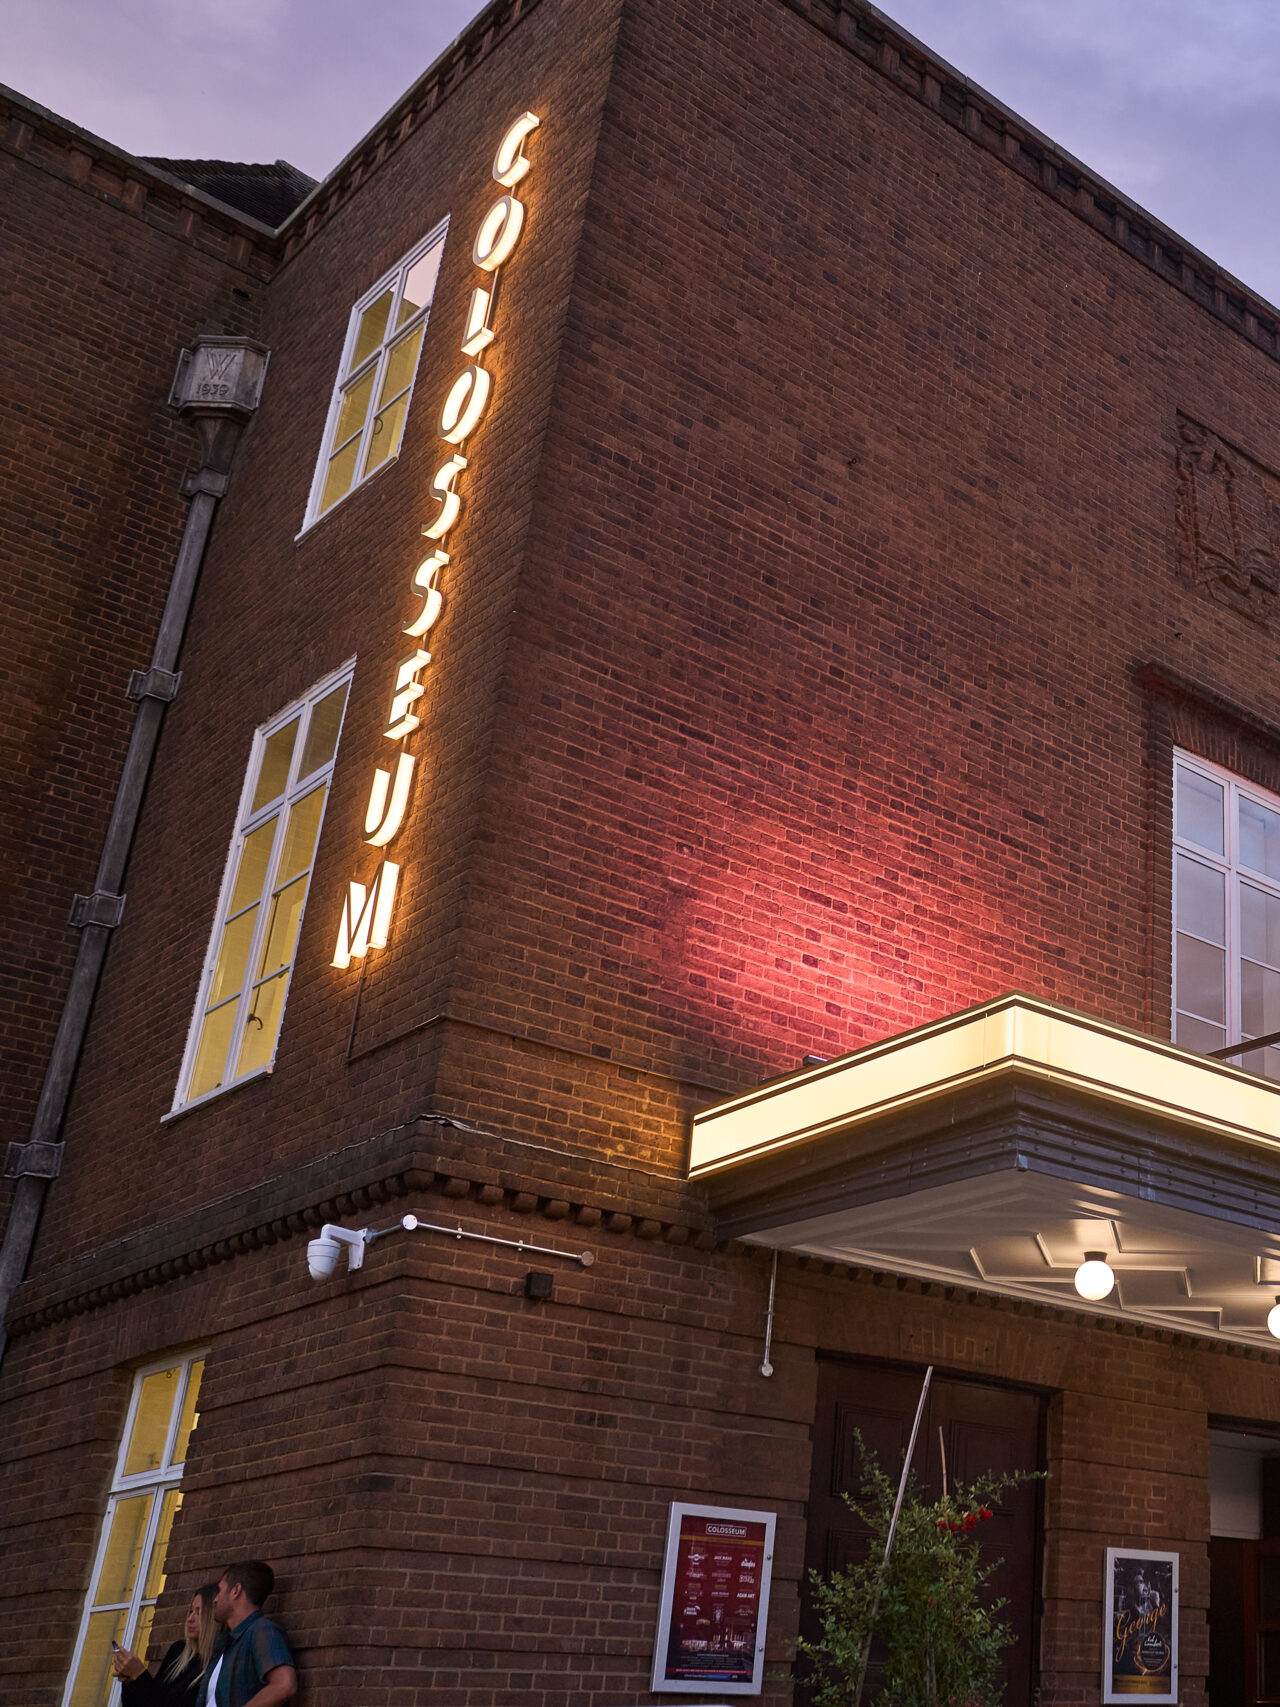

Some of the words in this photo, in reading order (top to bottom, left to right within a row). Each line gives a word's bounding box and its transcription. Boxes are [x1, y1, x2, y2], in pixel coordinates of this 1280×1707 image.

[196, 383, 230, 396] 1939
[329, 111, 541, 970] COLOSSEUM
[707, 1526, 746, 1535] COLOSSEUM
[1115, 1602, 1167, 1663] George
